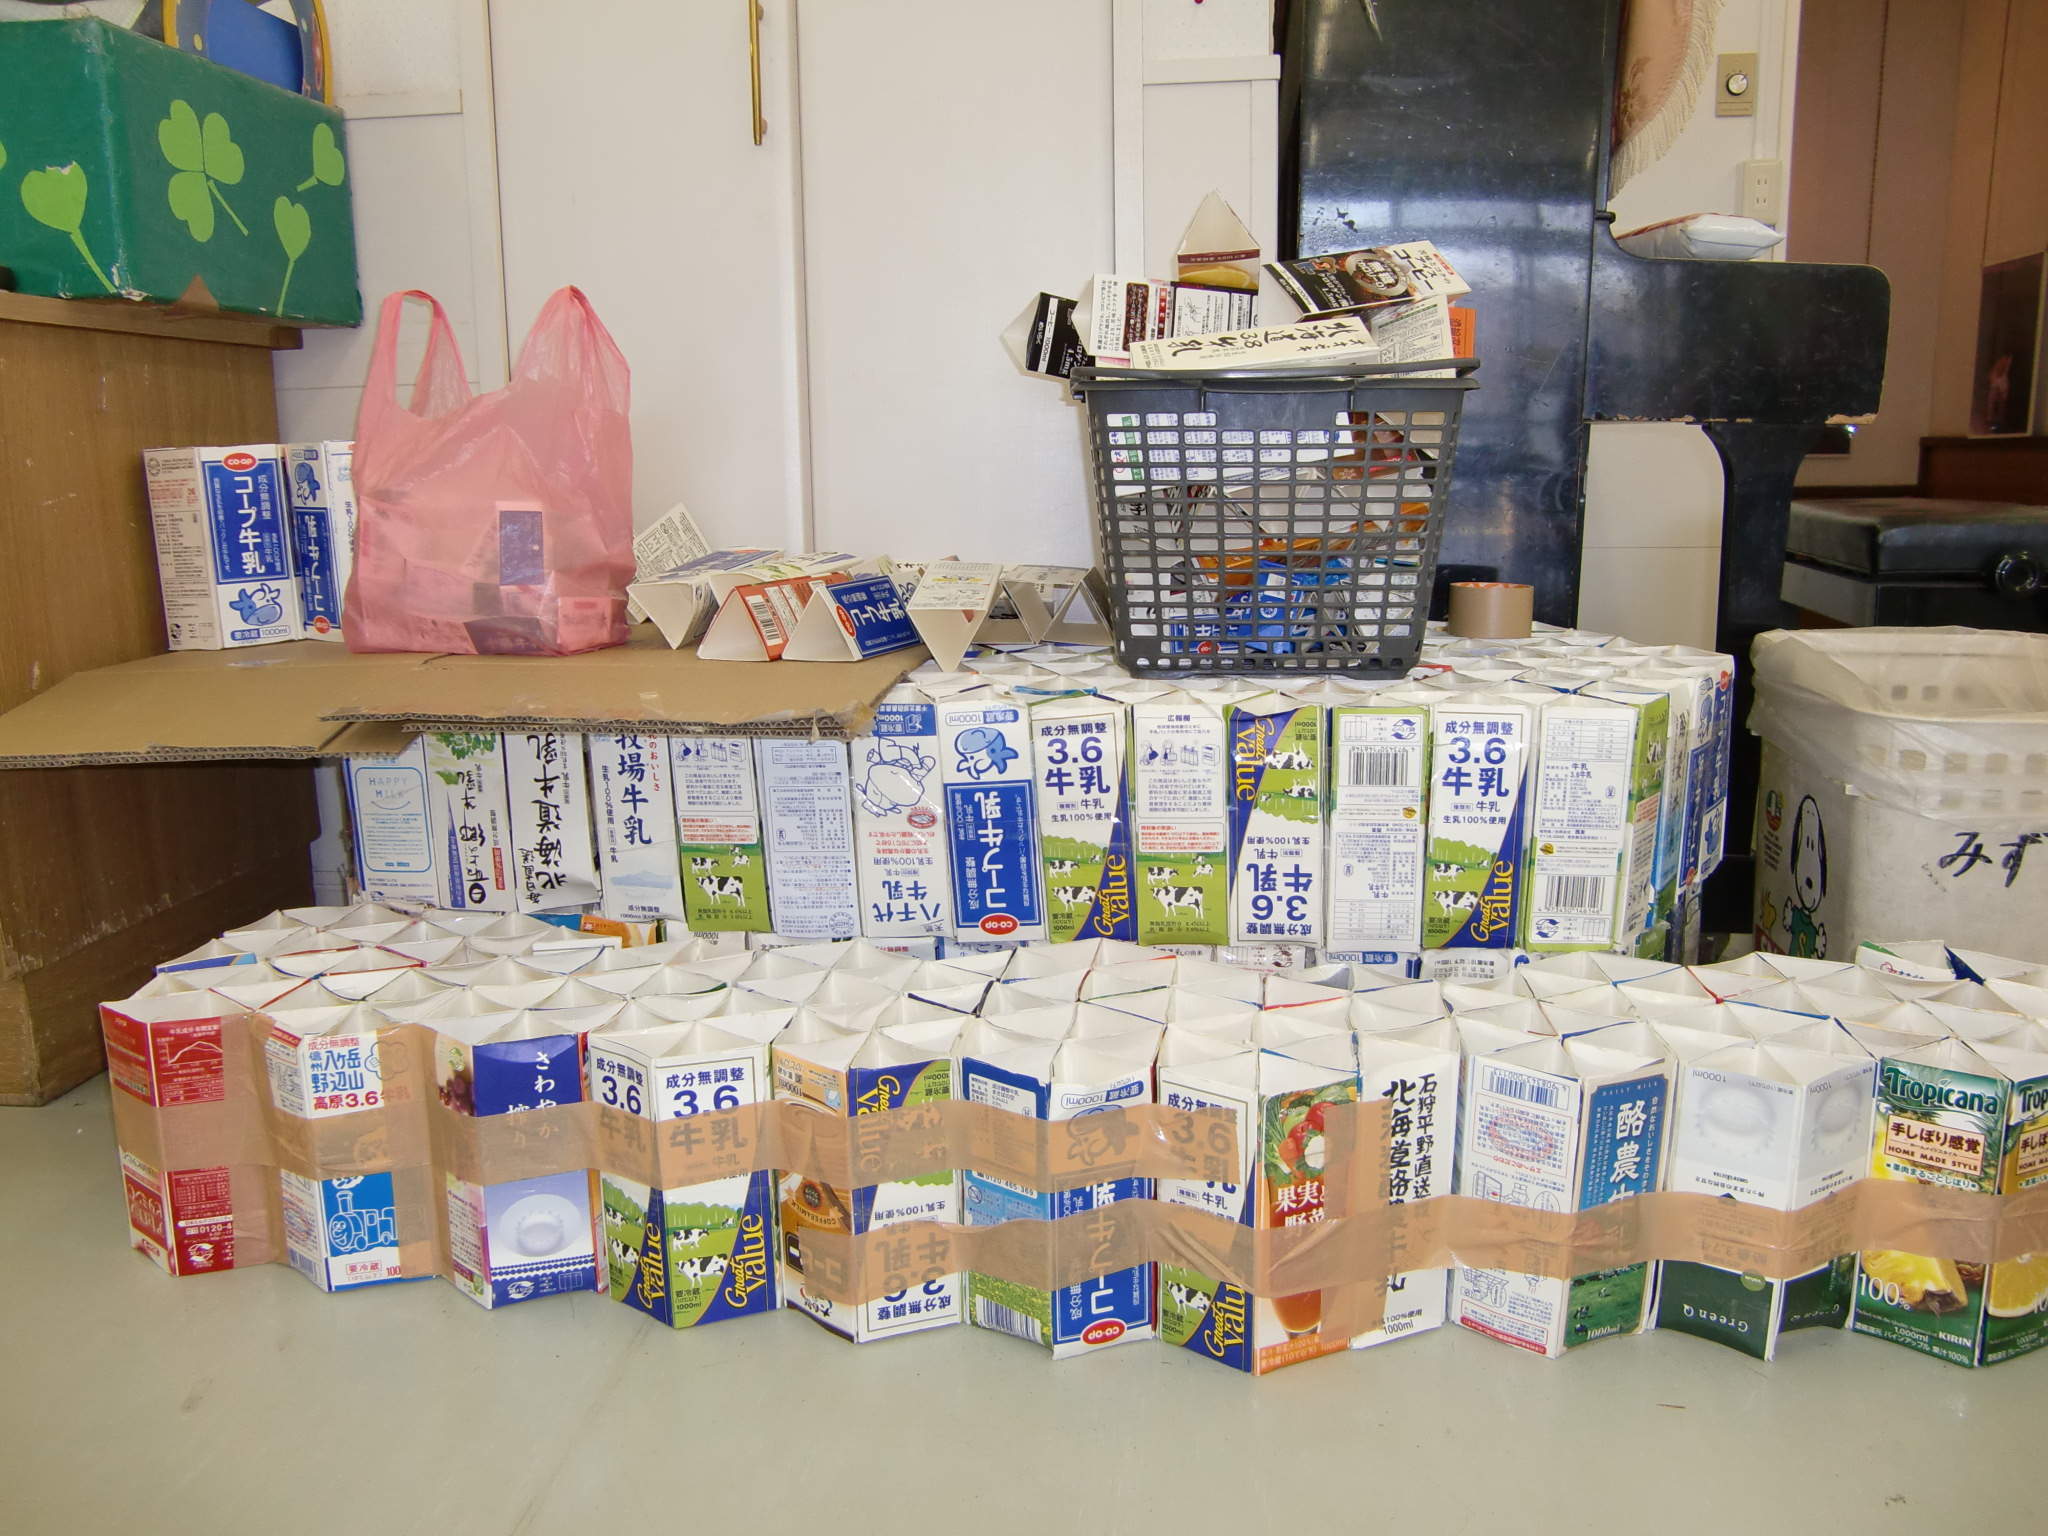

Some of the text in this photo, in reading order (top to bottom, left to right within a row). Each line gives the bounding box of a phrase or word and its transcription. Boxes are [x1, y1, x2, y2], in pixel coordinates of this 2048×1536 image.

[1392, 249, 1434, 291] コーヒー
[1041, 336, 1051, 362] 1000ml
[257, 474, 273, 520] 成分無調整
[234, 475, 266, 575] コープ牛乳
[304, 513, 326, 612] コープ牛乳
[849, 596, 907, 629] コープ牛乳
[261, 627, 289, 638] 1000ml
[949, 714, 982, 724] 1000ml
[1041, 722, 1107, 736] 成分無調整
[1294, 720, 1317, 728] 1000ml
[1444, 721, 1514, 736] 成分無調整
[1254, 717, 1275, 761] Great
[1047, 737, 1103, 764] 3.6
[1449, 737, 1507, 765] 3.6
[1570, 771, 1592, 779] 3.6牛乳
[1571, 763, 1589, 771] 牛乳
[368, 777, 407, 786] HAPPY
[1045, 766, 1111, 796] 牛乳
[1441, 767, 1510, 798] 牛乳
[602, 765, 615, 825] 生乳100%使用
[1081, 799, 1105, 810] 牛乳
[527, 733, 568, 890] 北海道牛乳
[964, 804, 974, 822] 牛乳
[1475, 800, 1501, 812] 牛乳
[1051, 813, 1112, 823] 生乳100%使用
[1442, 815, 1507, 825] 生乳100%使用
[974, 790, 1008, 909] コープ牛乳
[1246, 836, 1311, 845] 生乳100%使用
[610, 847, 618, 863] 牛乳
[872, 856, 933, 866] 生乳100%使用
[1254, 848, 1278, 859] 牛乳
[884, 868, 900, 877] 牛乳
[965, 855, 980, 910] 成分無調整
[1246, 863, 1313, 892] 牛乳
[881, 880, 928, 900] 牛乳
[1372, 890, 1389, 898] 牛乳
[628, 904, 661, 913] 成分無調整
[871, 901, 942, 923] 八千代
[1093, 891, 1112, 937] Great
[1251, 895, 1308, 921] 3.6
[1472, 895, 1491, 942] Great
[923, 922, 944, 933] 天然
[1053, 924, 1075, 932] 1000ml
[1246, 922, 1312, 935] 成分無調整
[1328, 953, 1361, 962] 1000ml
[308, 1036, 361, 1051] 成分無調整
[311, 1070, 365, 1094] 野辺山
[596, 1057, 645, 1088] 成分無調整
[665, 1067, 746, 1089] 成分無調整
[923, 1073, 949, 1081] 1000ml
[1691, 1069, 1727, 1083] 1000ml
[602, 1075, 642, 1115] 3.6
[778, 1078, 804, 1096] 1000ml
[924, 1086, 950, 1095] 要冷蔵
[1066, 1084, 1139, 1106] 1000ml 要冷蔵
[1602, 1081, 1659, 1097] DAILY MILK
[1809, 1081, 1833, 1096] 1000ml
[1884, 1066, 1999, 1115] Tropicana
[672, 1085, 740, 1120] 3.6
[1171, 1112, 1232, 1155] 3.6
[1413, 1072, 1438, 1202] 石狩平野直送
[1890, 1121, 1982, 1155] 手しぼり感覚
[1492, 1155, 1542, 1174] エサへのこだわり
[1888, 1145, 1979, 1173] HOME MADE STYLE
[2018, 1161, 2037, 1171] HOME
[1694, 1175, 1766, 1198] 搾ったままの自然な甘さ
[874, 1200, 946, 1220] 生乳100%使用
[1202, 1190, 1228, 1211] 牛乳
[348, 1262, 380, 1272] 要冷蔵
[636, 1259, 654, 1309] Great
[725, 1253, 748, 1308] Great
[882, 1264, 946, 1303] 3.6
[1859, 1273, 1911, 1311] 100%
[676, 1302, 702, 1311] 1000ml
[876, 1294, 952, 1319] 成分無調整
[1682, 1302, 1749, 1332] Q Green
[1203, 1282, 1246, 1357] Great Valu
[1383, 1321, 1414, 1335] 1000ml
[1586, 1323, 1620, 1341] 1000ml
[1938, 1331, 1973, 1348] KIRIN
[1883, 1330, 1931, 1351] パインアップル
[1932, 1345, 1970, 1365] 果汁100%
